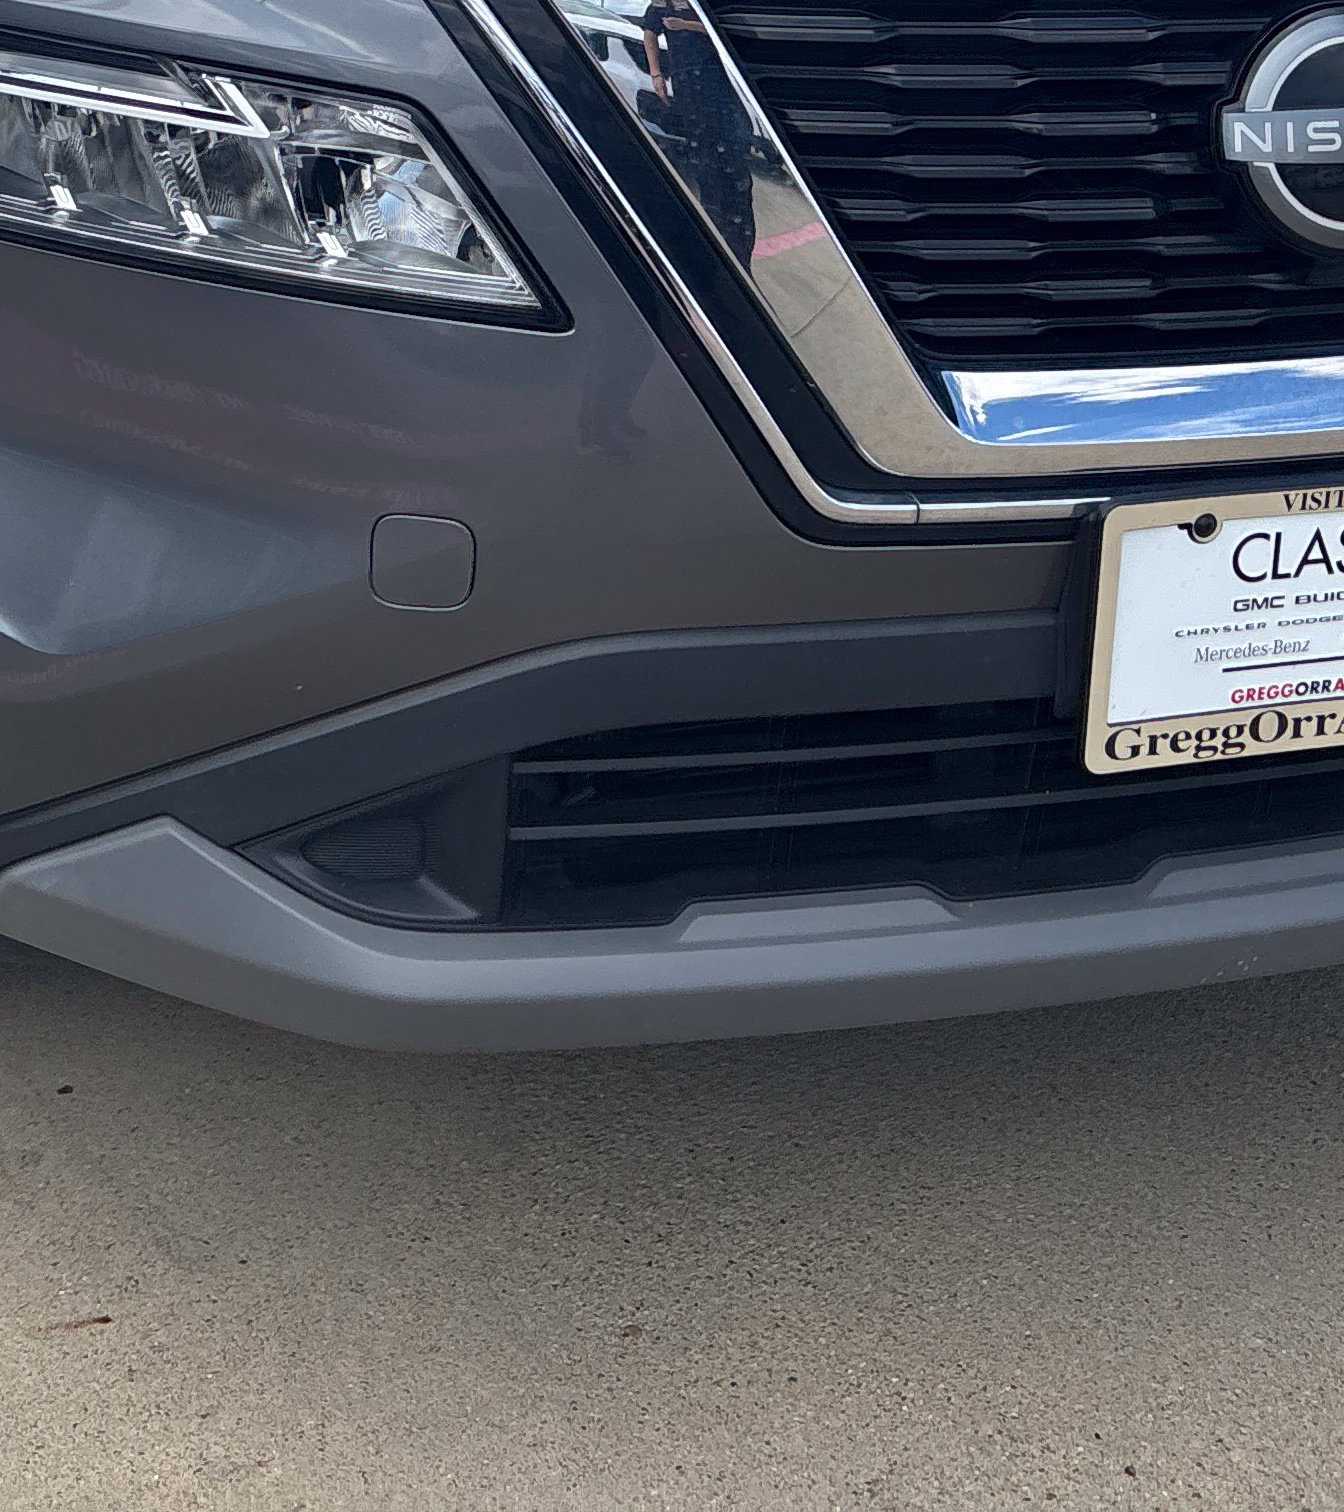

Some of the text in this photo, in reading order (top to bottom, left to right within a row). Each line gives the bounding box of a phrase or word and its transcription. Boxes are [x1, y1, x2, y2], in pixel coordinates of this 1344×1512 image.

[1233, 595, 1286, 613] GMC
[1174, 621, 1267, 638] CHRYSLER
[1277, 614, 1344, 628] DODGE
[1193, 637, 1311, 664] Mercedes-Benz
